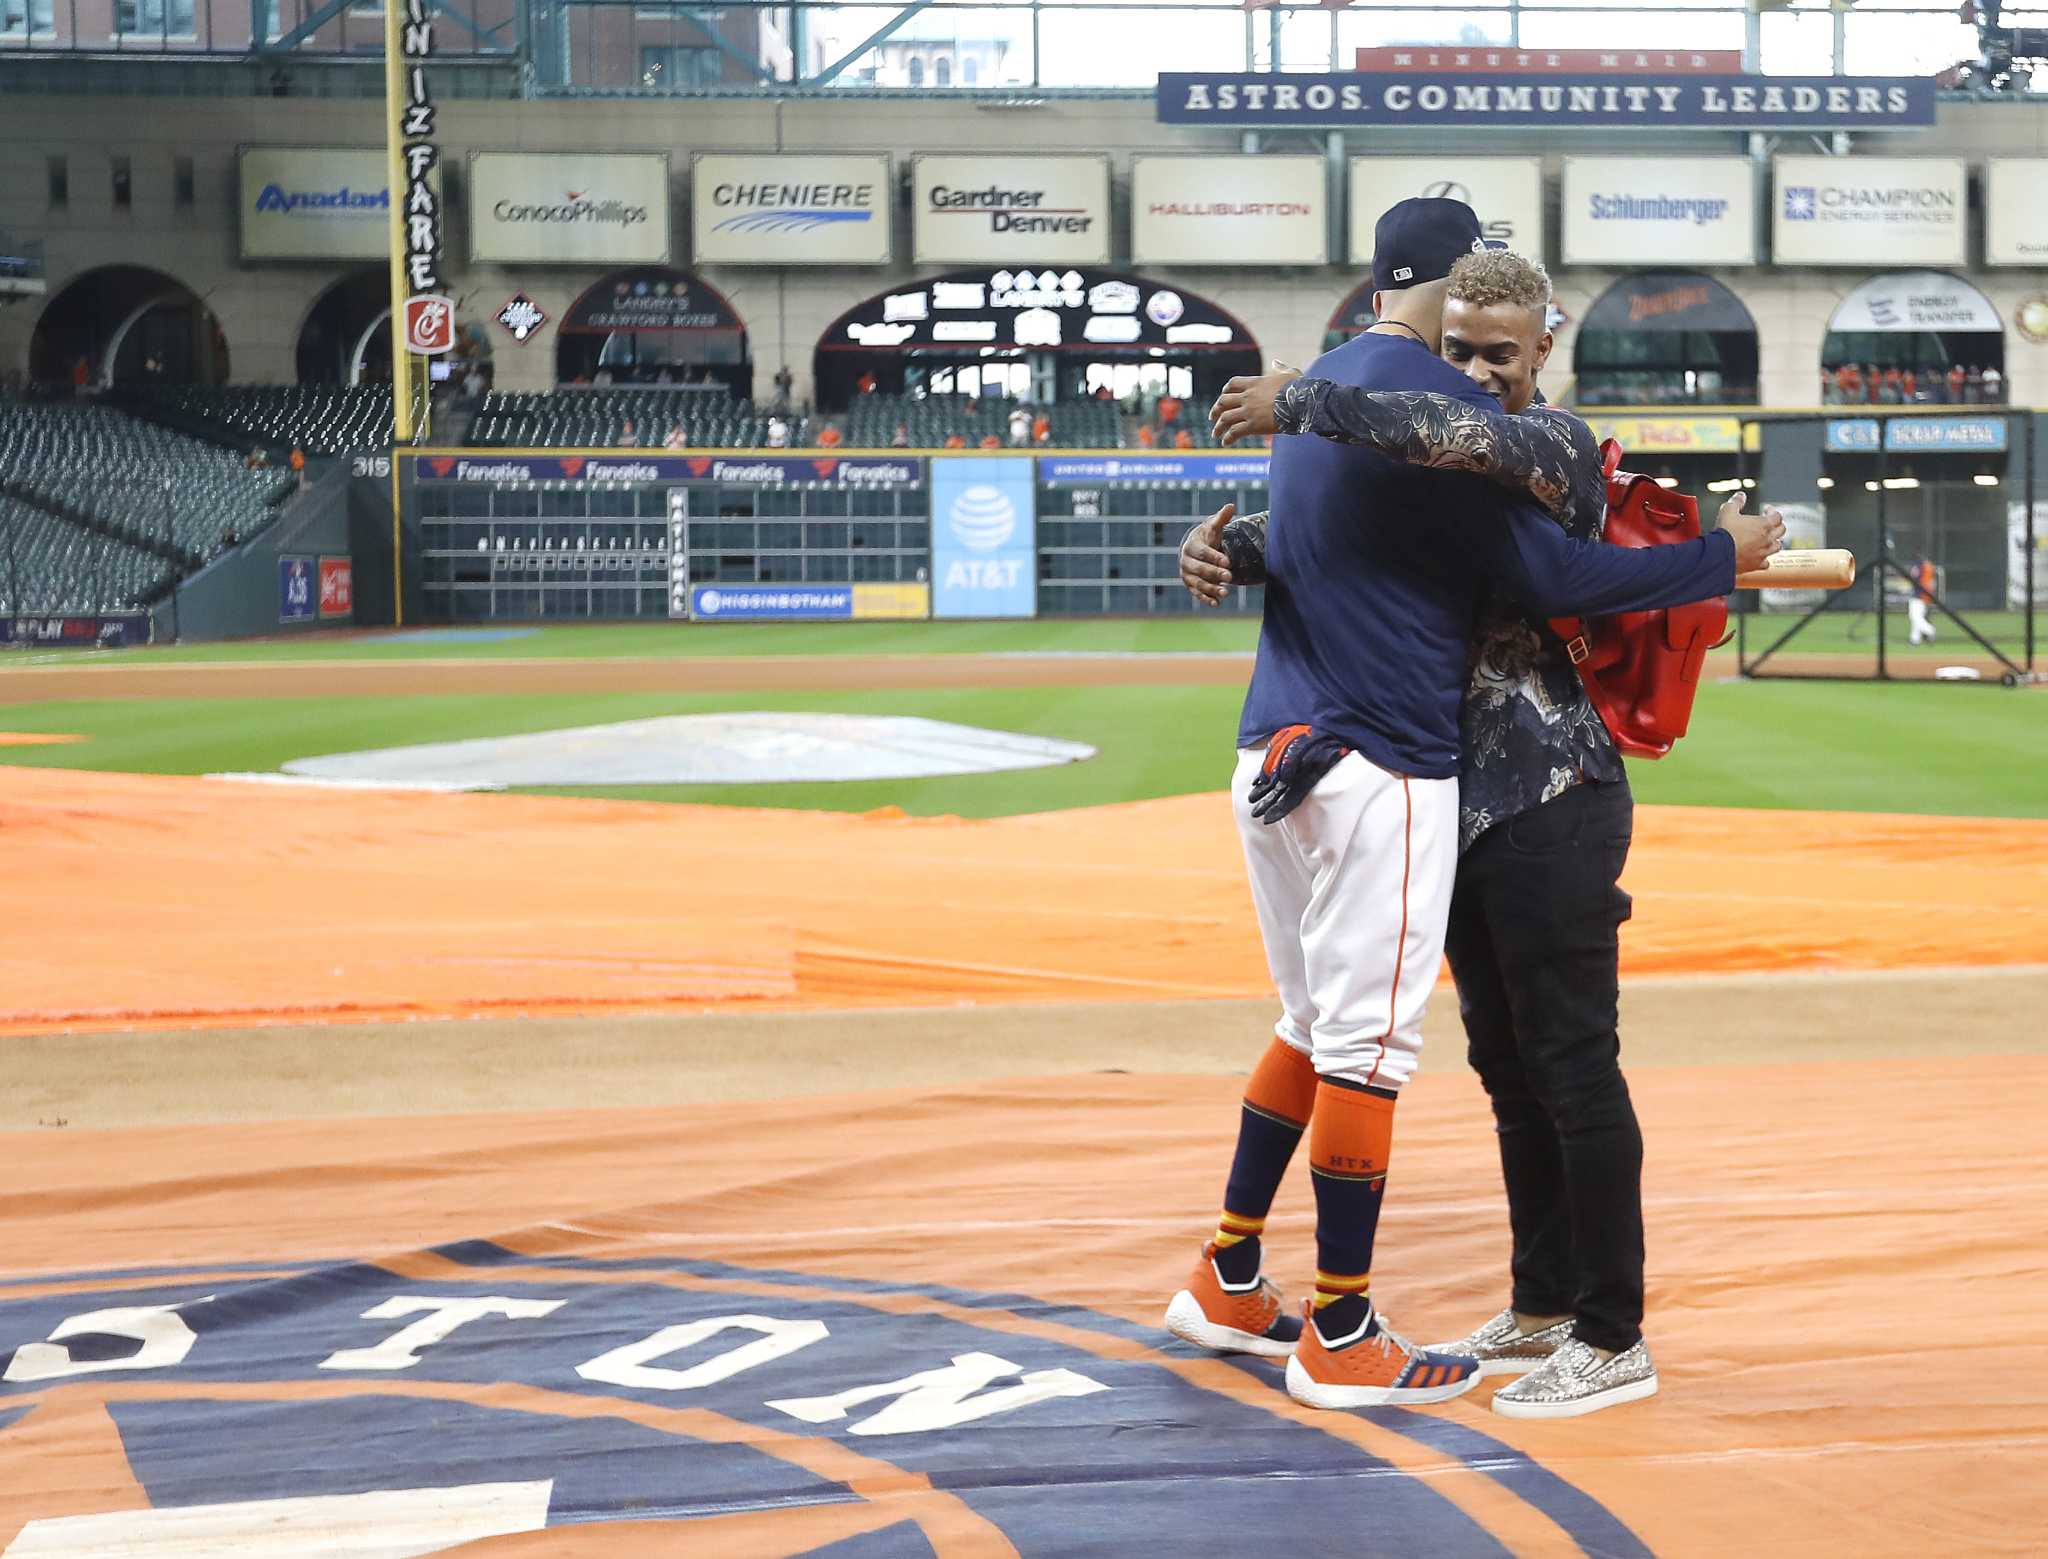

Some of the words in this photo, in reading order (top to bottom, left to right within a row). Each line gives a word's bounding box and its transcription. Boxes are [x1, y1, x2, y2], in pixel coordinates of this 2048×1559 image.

[1393, 53, 1561, 67] MINUTE
[1599, 54, 1708, 67] MAID
[1184, 84, 1364, 111] ASTROS
[1383, 85, 1683, 112] COMMUNITY
[1700, 86, 1909, 113] LEADERS
[713, 183, 873, 207] CHENIERE
[930, 186, 1044, 207] Gardner
[1820, 187, 1956, 207] CHAMPION
[494, 199, 648, 228] ConocoPhillips
[1150, 202, 1312, 216] HALLIBURTON
[1589, 193, 1729, 225] Schlumberger
[992, 211, 1094, 233] Denver
[352, 456, 391, 478] 315
[457, 461, 531, 481] Fanatics
[585, 461, 659, 481] Fanatics
[713, 461, 785, 481] Fanatics
[838, 461, 910, 481] Fanatics
[945, 559, 1025, 591] AT&T
[1329, 1154, 1373, 1169] HTX
